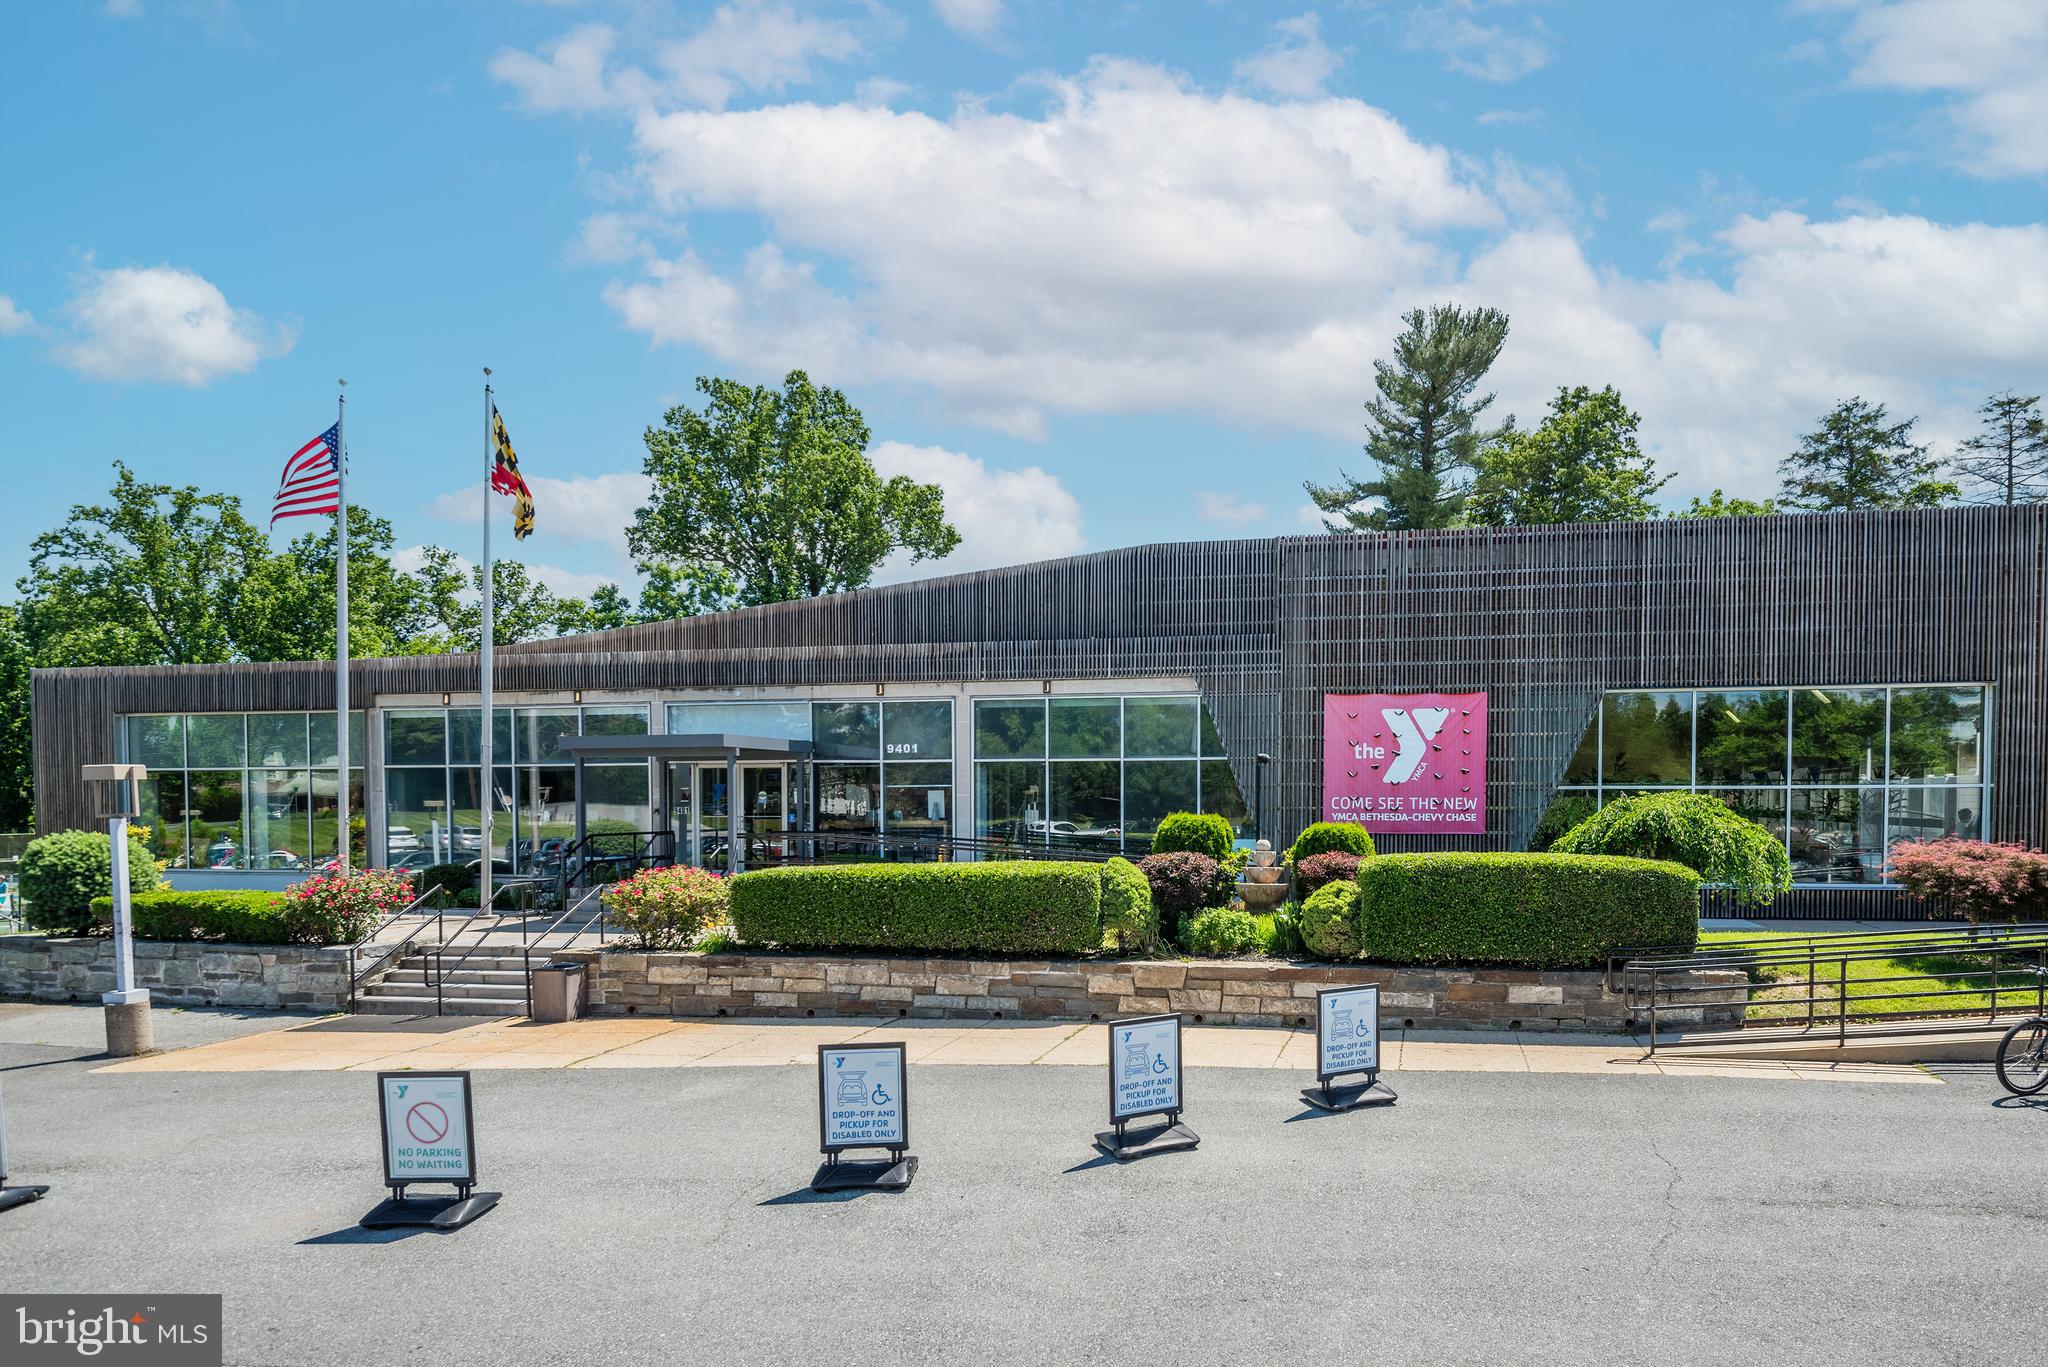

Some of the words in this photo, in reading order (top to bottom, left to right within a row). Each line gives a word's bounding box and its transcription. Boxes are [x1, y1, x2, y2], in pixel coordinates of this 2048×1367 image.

[887, 744, 918, 753] 9401
[1354, 743, 1384, 759] the
[1411, 762, 1428, 782] YMCA
[1331, 797, 1373, 810] COME
[1378, 797, 1404, 810] SEE
[1409, 797, 1438, 810] THE
[1443, 797, 1478, 810] NEW
[1331, 812, 1359, 821] YMCA
[1446, 813, 1477, 822] CHASE
[1327, 1042, 1358, 1052] DROP-OFF
[1360, 1040, 1372, 1048] AND
[1332, 1051, 1354, 1060] PICKUP
[1356, 1049, 1367, 1057] FOR
[1326, 1060, 1355, 1069] DISABLED
[1357, 1057, 1372, 1065] ONLY
[1120, 1079, 1155, 1091] DROP-OFF
[1157, 1077, 1173, 1086] AND
[1126, 1089, 1151, 1100] PICKUP
[1153, 1087, 1166, 1096] FOR
[1120, 1099, 1153, 1111] DISABLED
[1155, 1096, 1173, 1105] ONLY
[832, 1110, 875, 1119] DROP-OFF
[877, 1109, 896, 1117] AND
[840, 1120, 870, 1129] PICKUP
[872, 1119, 889, 1127] FOR
[832, 1130, 872, 1140] DISABLED
[874, 1129, 897, 1137] ONLY
[398, 1148, 413, 1157] NO
[416, 1148, 462, 1157] PARKING
[398, 1160, 413, 1169] NO
[416, 1160, 463, 1169] WAITING
